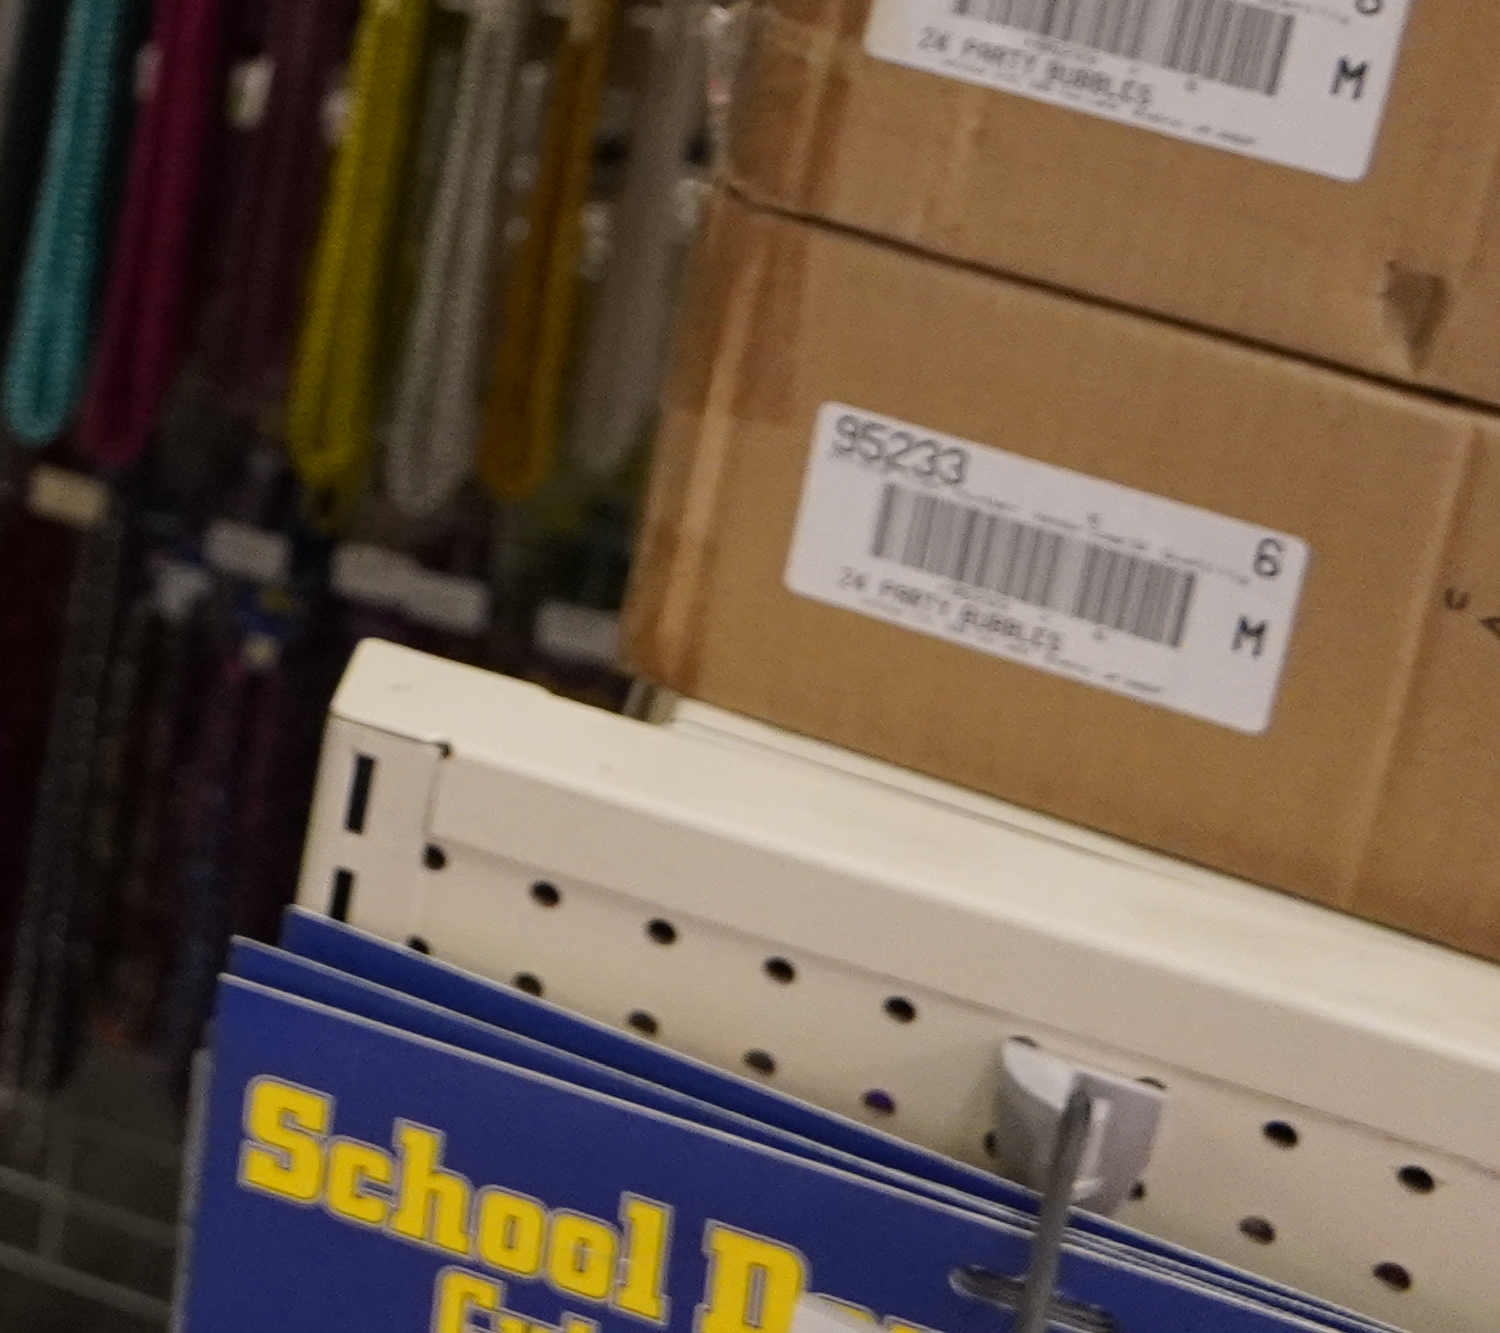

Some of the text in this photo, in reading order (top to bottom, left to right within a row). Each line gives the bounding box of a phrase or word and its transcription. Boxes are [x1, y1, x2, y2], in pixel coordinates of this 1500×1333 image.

[1330, 56, 1370, 100] M
[832, 414, 970, 485] 95233
[1253, 537, 1285, 578] 6
[1230, 614, 1269, 659] M
[239, 1076, 675, 1324] School
